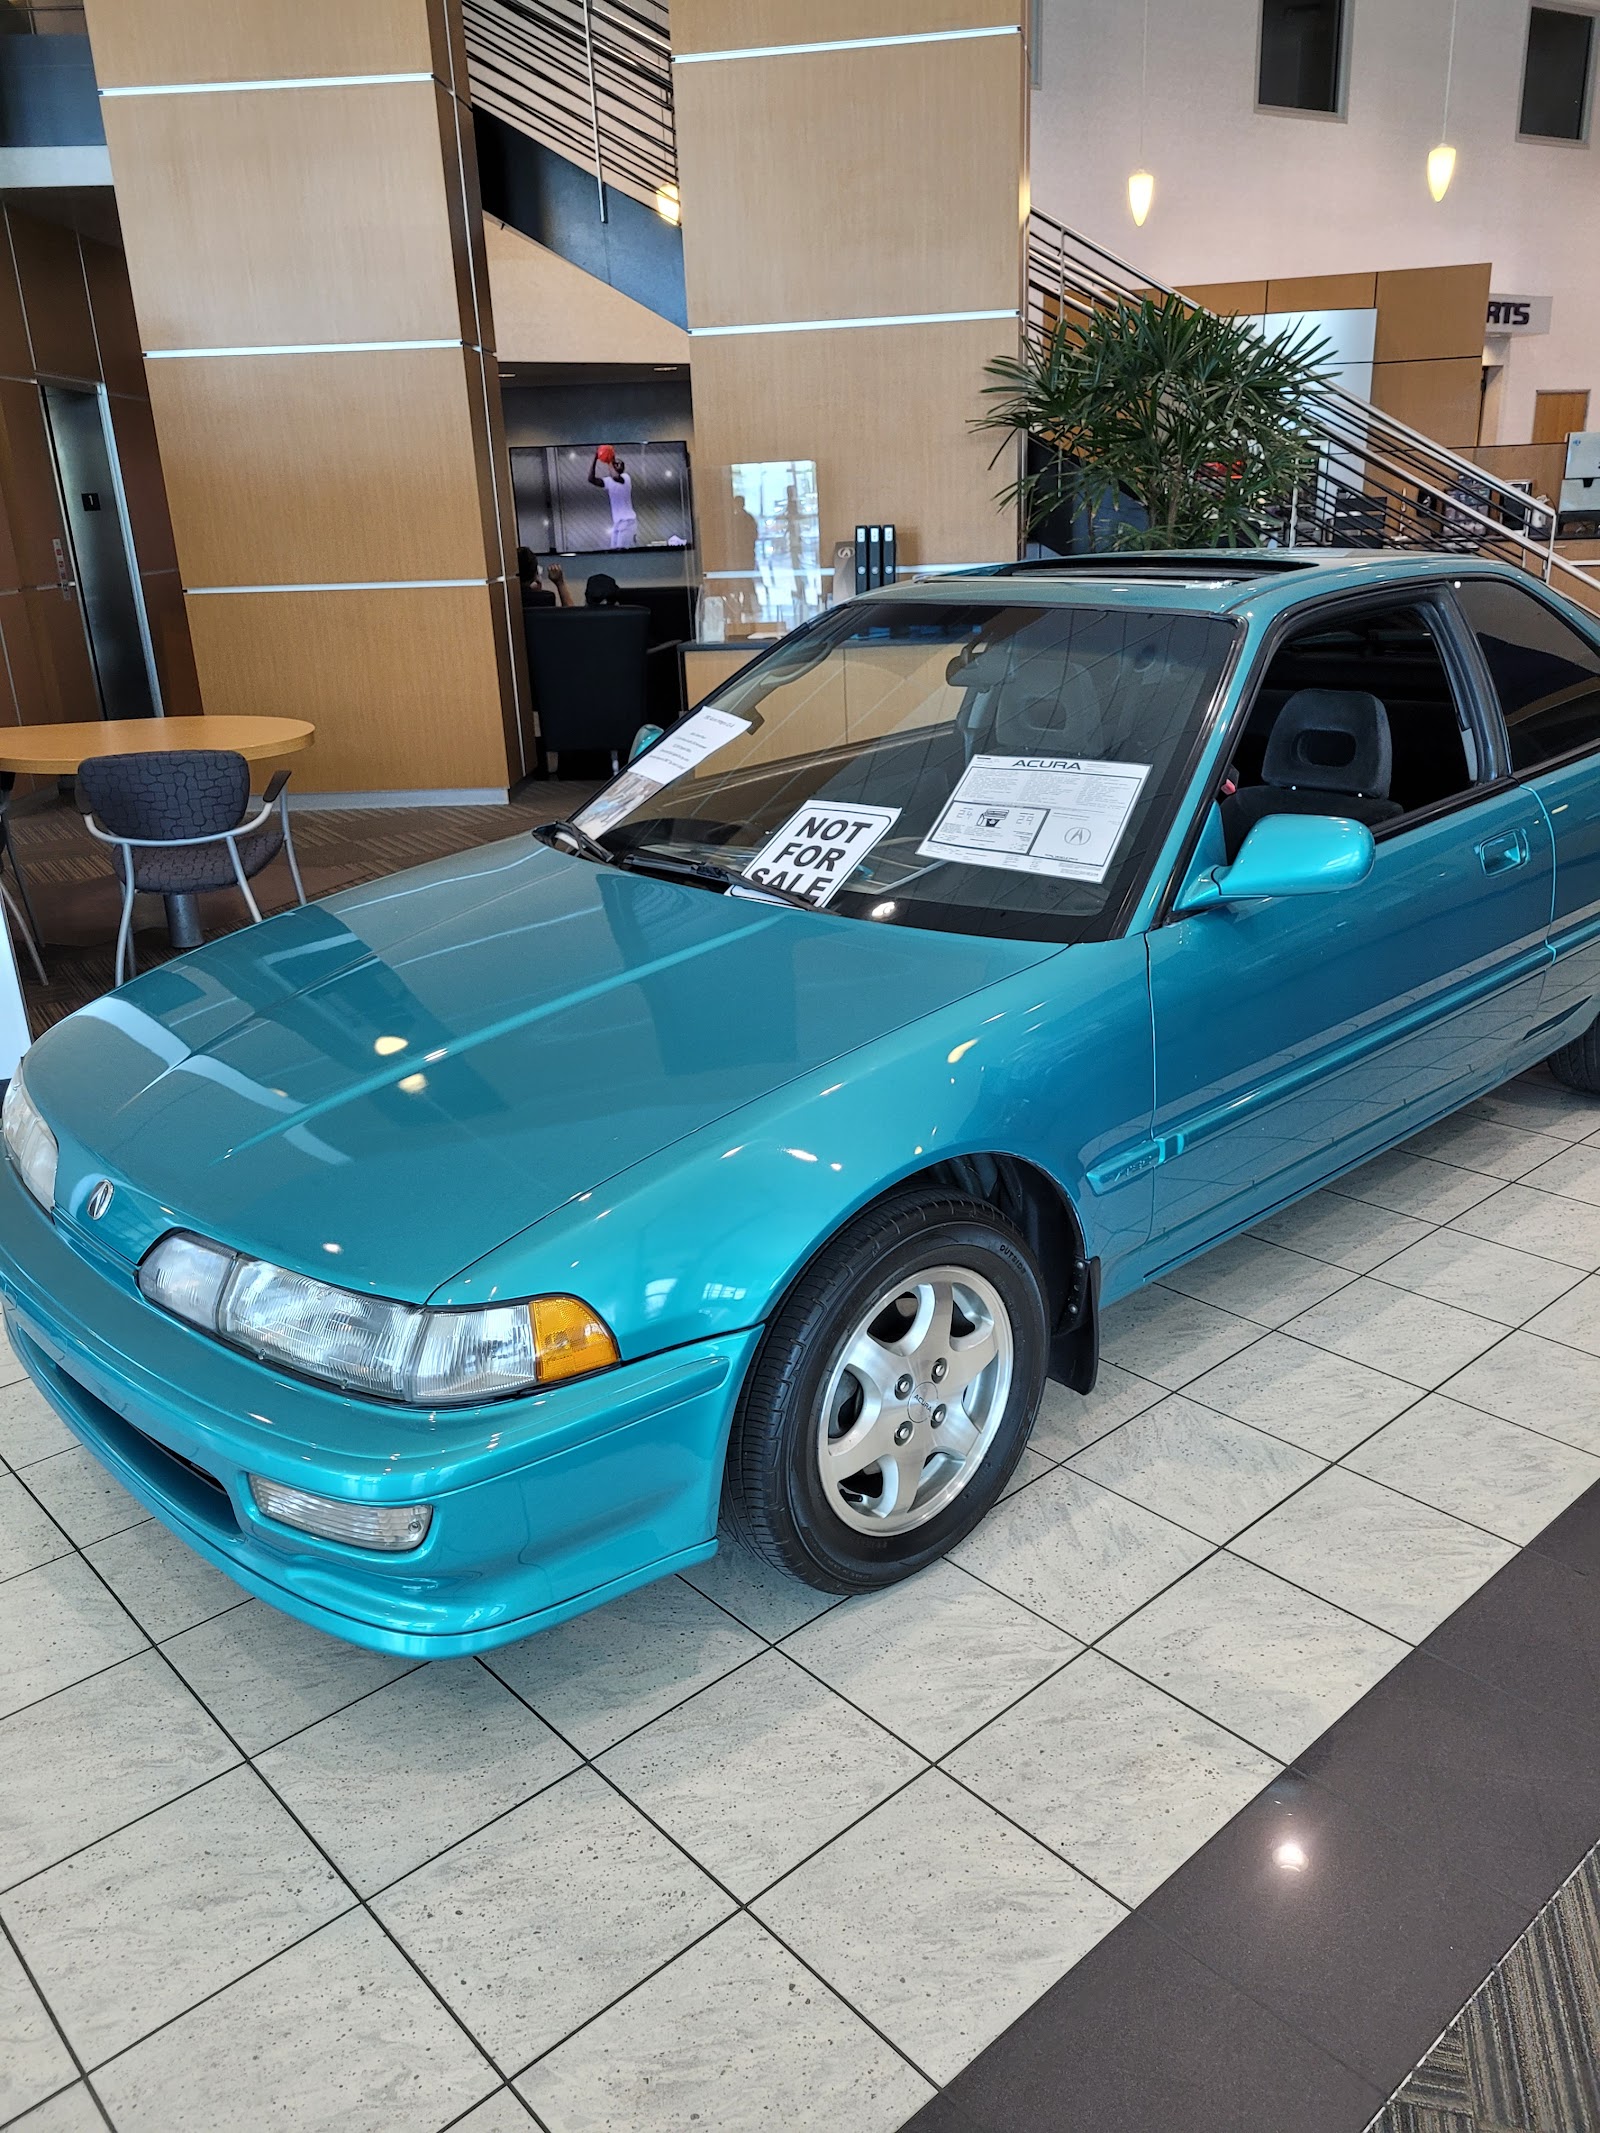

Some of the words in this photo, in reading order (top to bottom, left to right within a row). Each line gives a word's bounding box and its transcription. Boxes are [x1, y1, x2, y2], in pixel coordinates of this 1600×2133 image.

[1012, 759, 1081, 771] ACURA
[794, 816, 873, 844] NOT
[772, 842, 846, 872] FOR
[751, 867, 834, 902] SALE
[914, 1394, 932, 1412] ACURA
